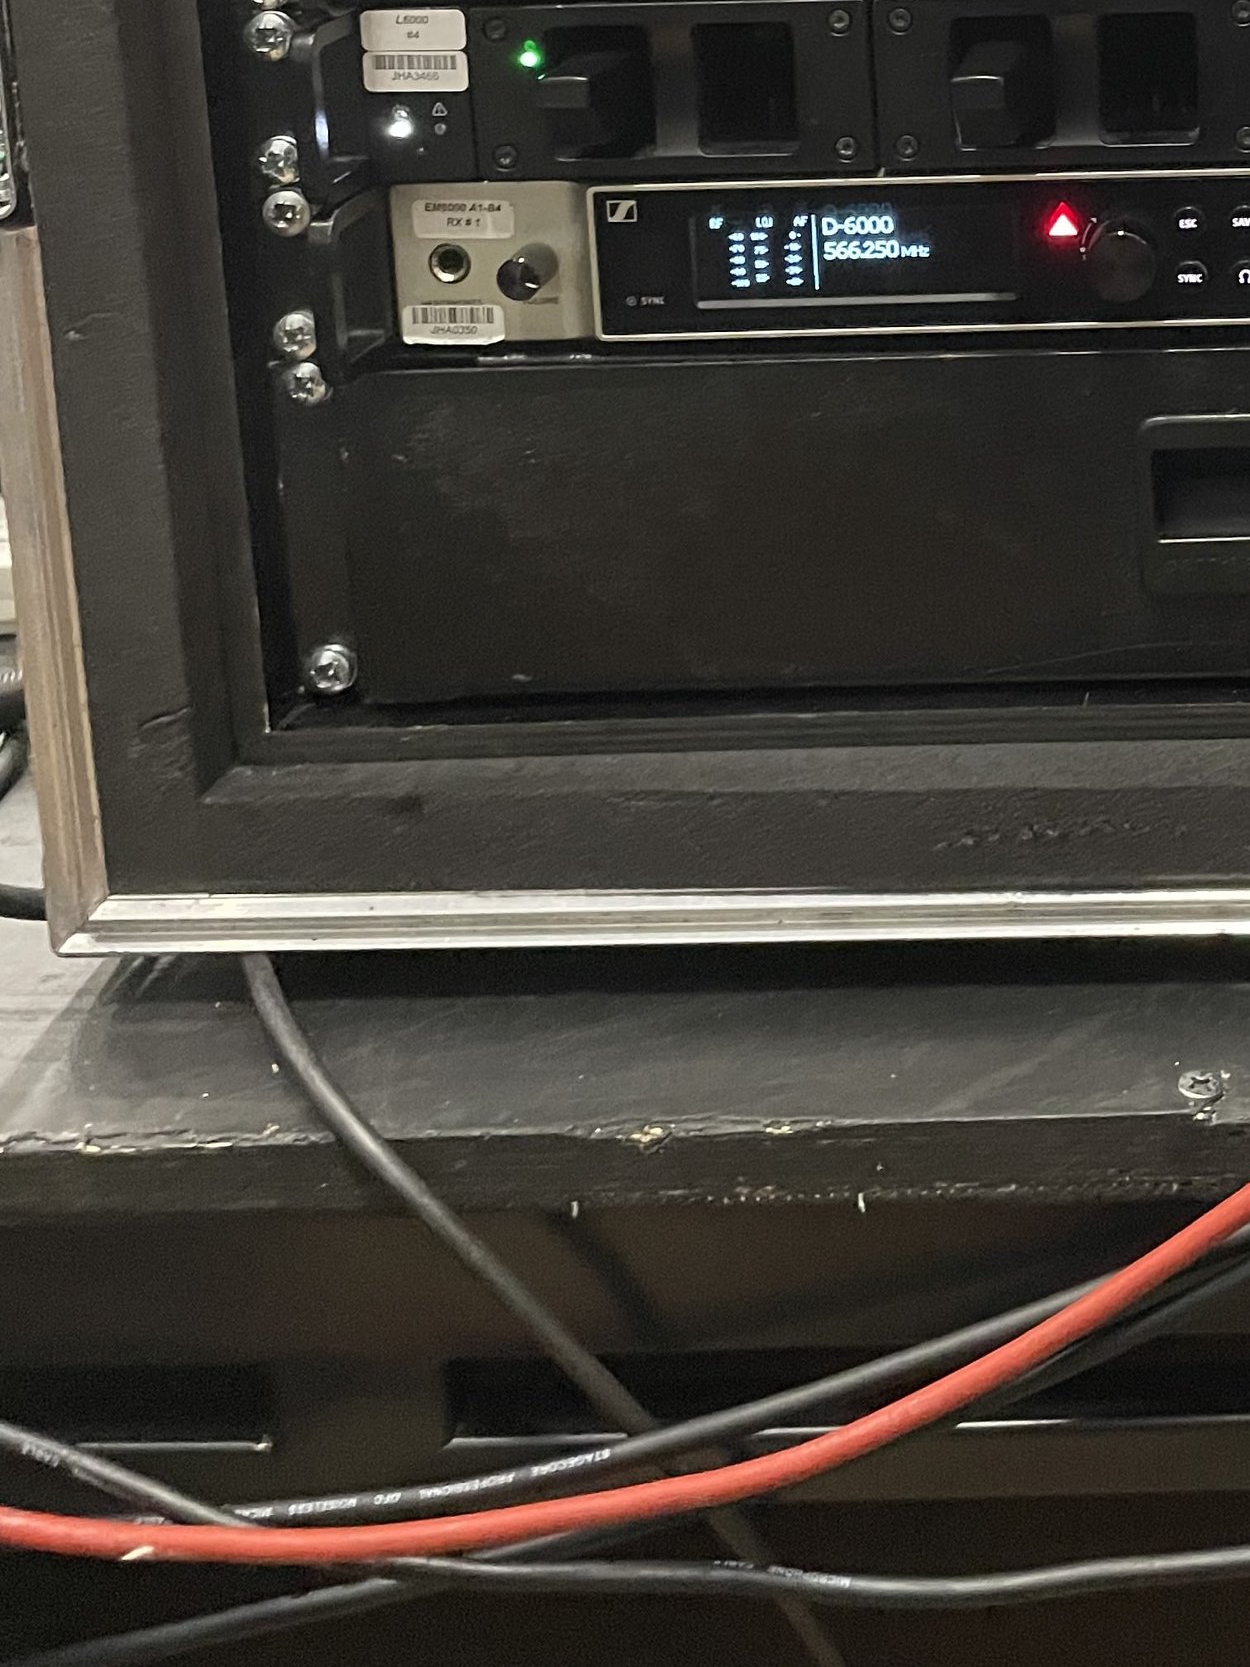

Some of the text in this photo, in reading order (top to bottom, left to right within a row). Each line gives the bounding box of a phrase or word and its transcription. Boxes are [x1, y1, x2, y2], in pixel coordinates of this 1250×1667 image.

[446, 217, 463, 228] RX
[793, 215, 808, 227] AF
[821, 215, 894, 236] D-6000
[1178, 218, 1198, 229] ESC
[1177, 273, 1203, 284] SYNC
[639, 295, 666, 306] SYNC
